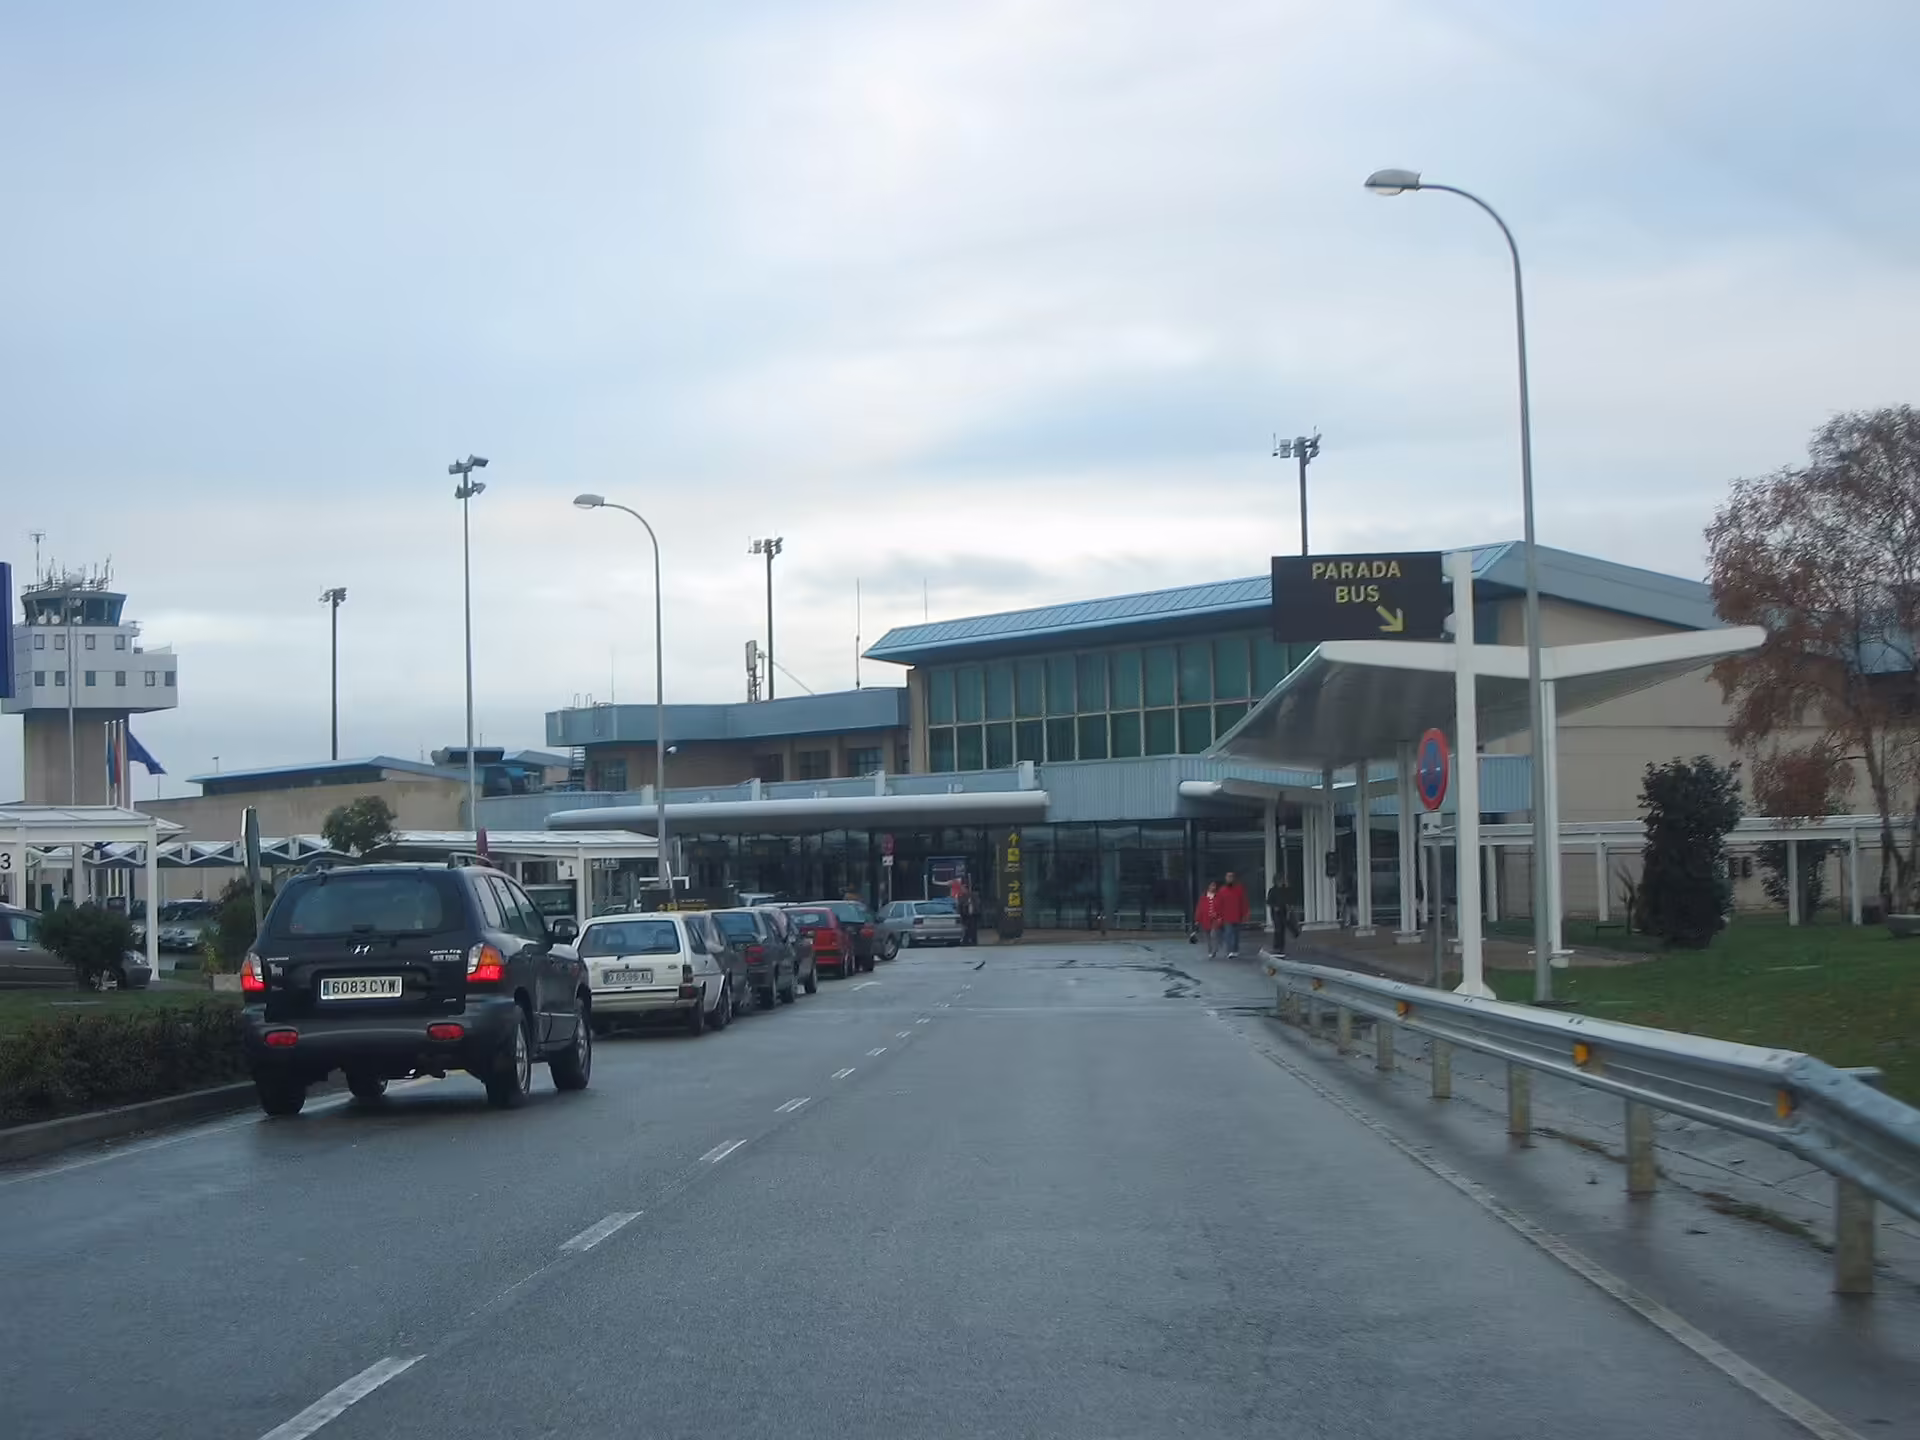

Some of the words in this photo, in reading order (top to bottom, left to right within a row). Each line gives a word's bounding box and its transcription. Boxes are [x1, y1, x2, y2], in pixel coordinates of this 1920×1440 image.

[1311, 560, 1402, 580] PARADA
[1335, 585, 1380, 603] BUS
[0, 852, 11, 870] 3
[332, 980, 367, 994] 6083
[369, 979, 397, 993] CYW
